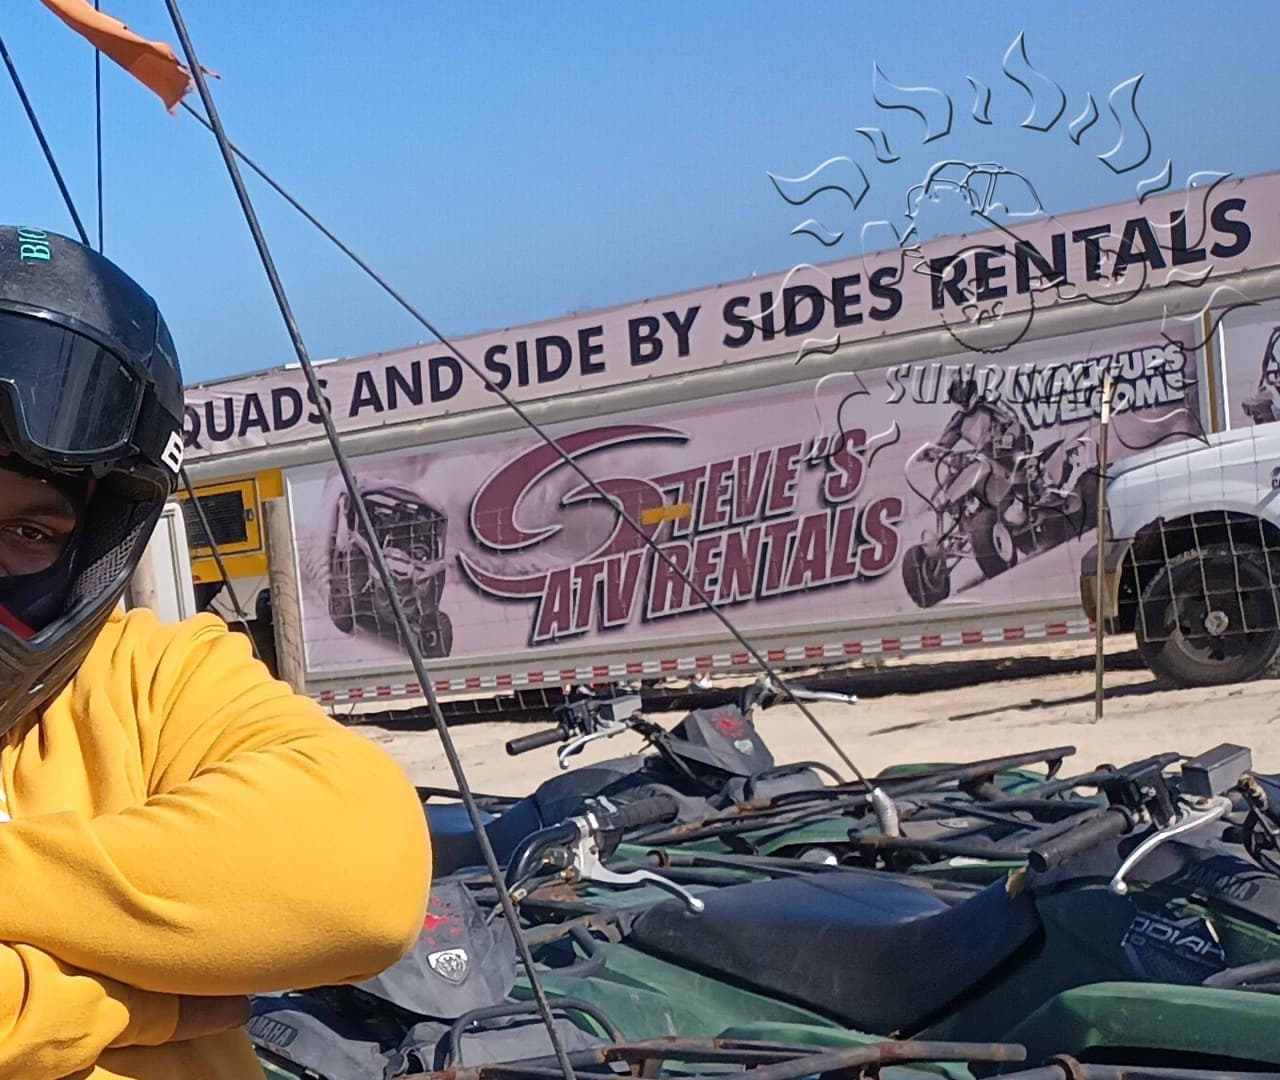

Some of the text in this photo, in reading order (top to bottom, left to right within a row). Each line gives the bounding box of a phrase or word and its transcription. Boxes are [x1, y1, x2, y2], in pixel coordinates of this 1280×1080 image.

[181, 198, 1252, 450] QUADS AND SIDE BY SIDES RENTALS
[1020, 372, 1186, 430] WELCOME
[532, 496, 904, 643] ATV RENTALS
